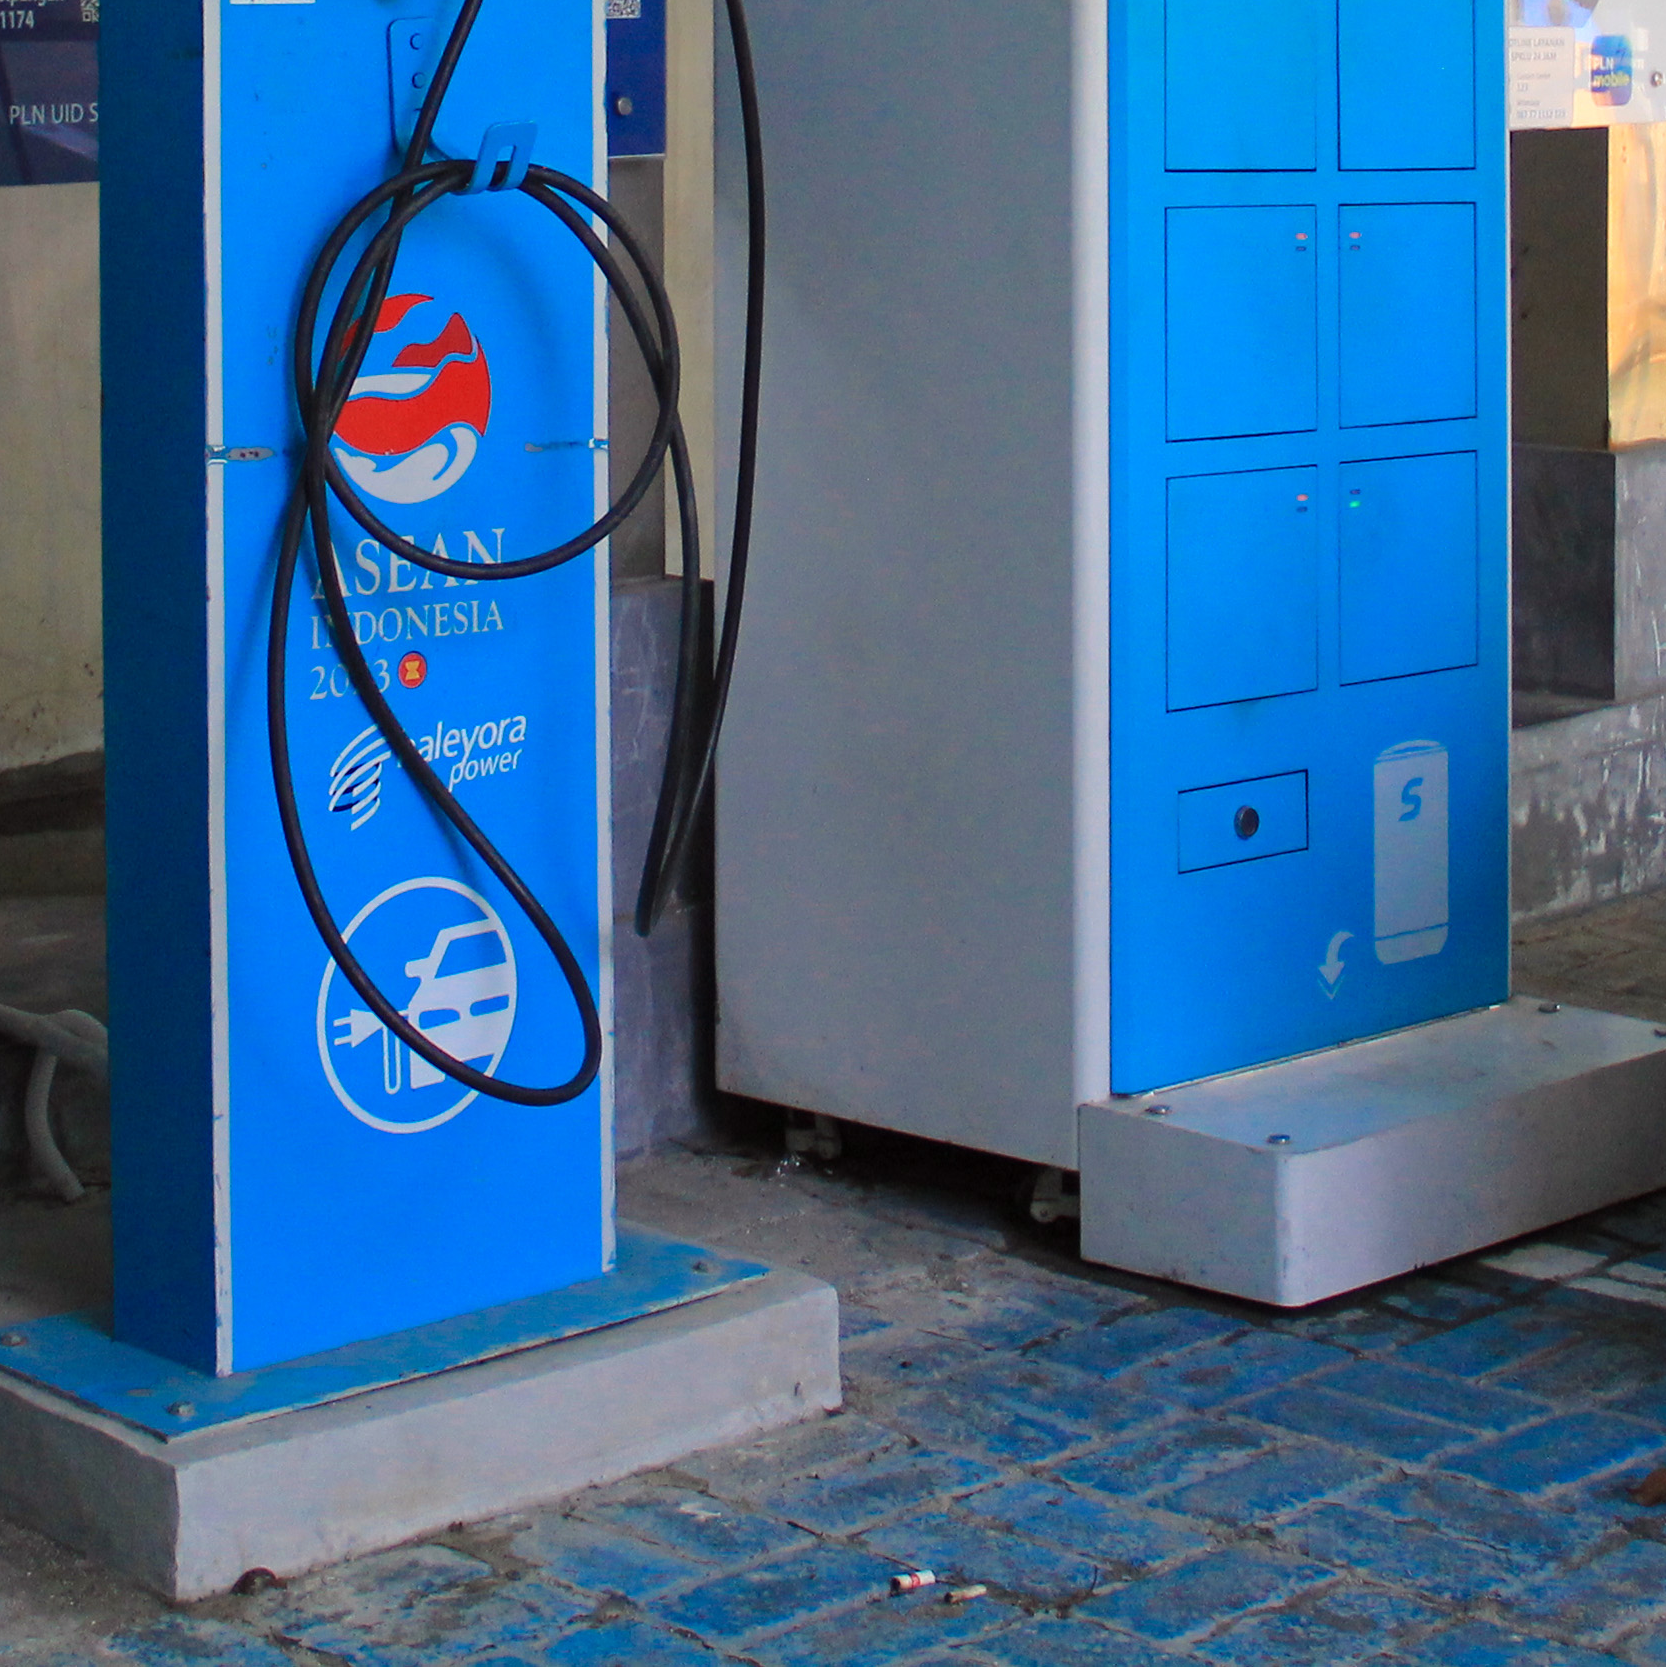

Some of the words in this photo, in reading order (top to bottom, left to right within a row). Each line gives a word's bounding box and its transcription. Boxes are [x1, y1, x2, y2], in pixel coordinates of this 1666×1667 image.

[9, 104, 47, 126] PLN
[50, 102, 84, 125] UID
[310, 527, 505, 601] ASEAN
[310, 600, 504, 650] IDONESIA
[310, 659, 392, 700] 203
[397, 714, 527, 768] aleyora
[448, 748, 523, 793] power
